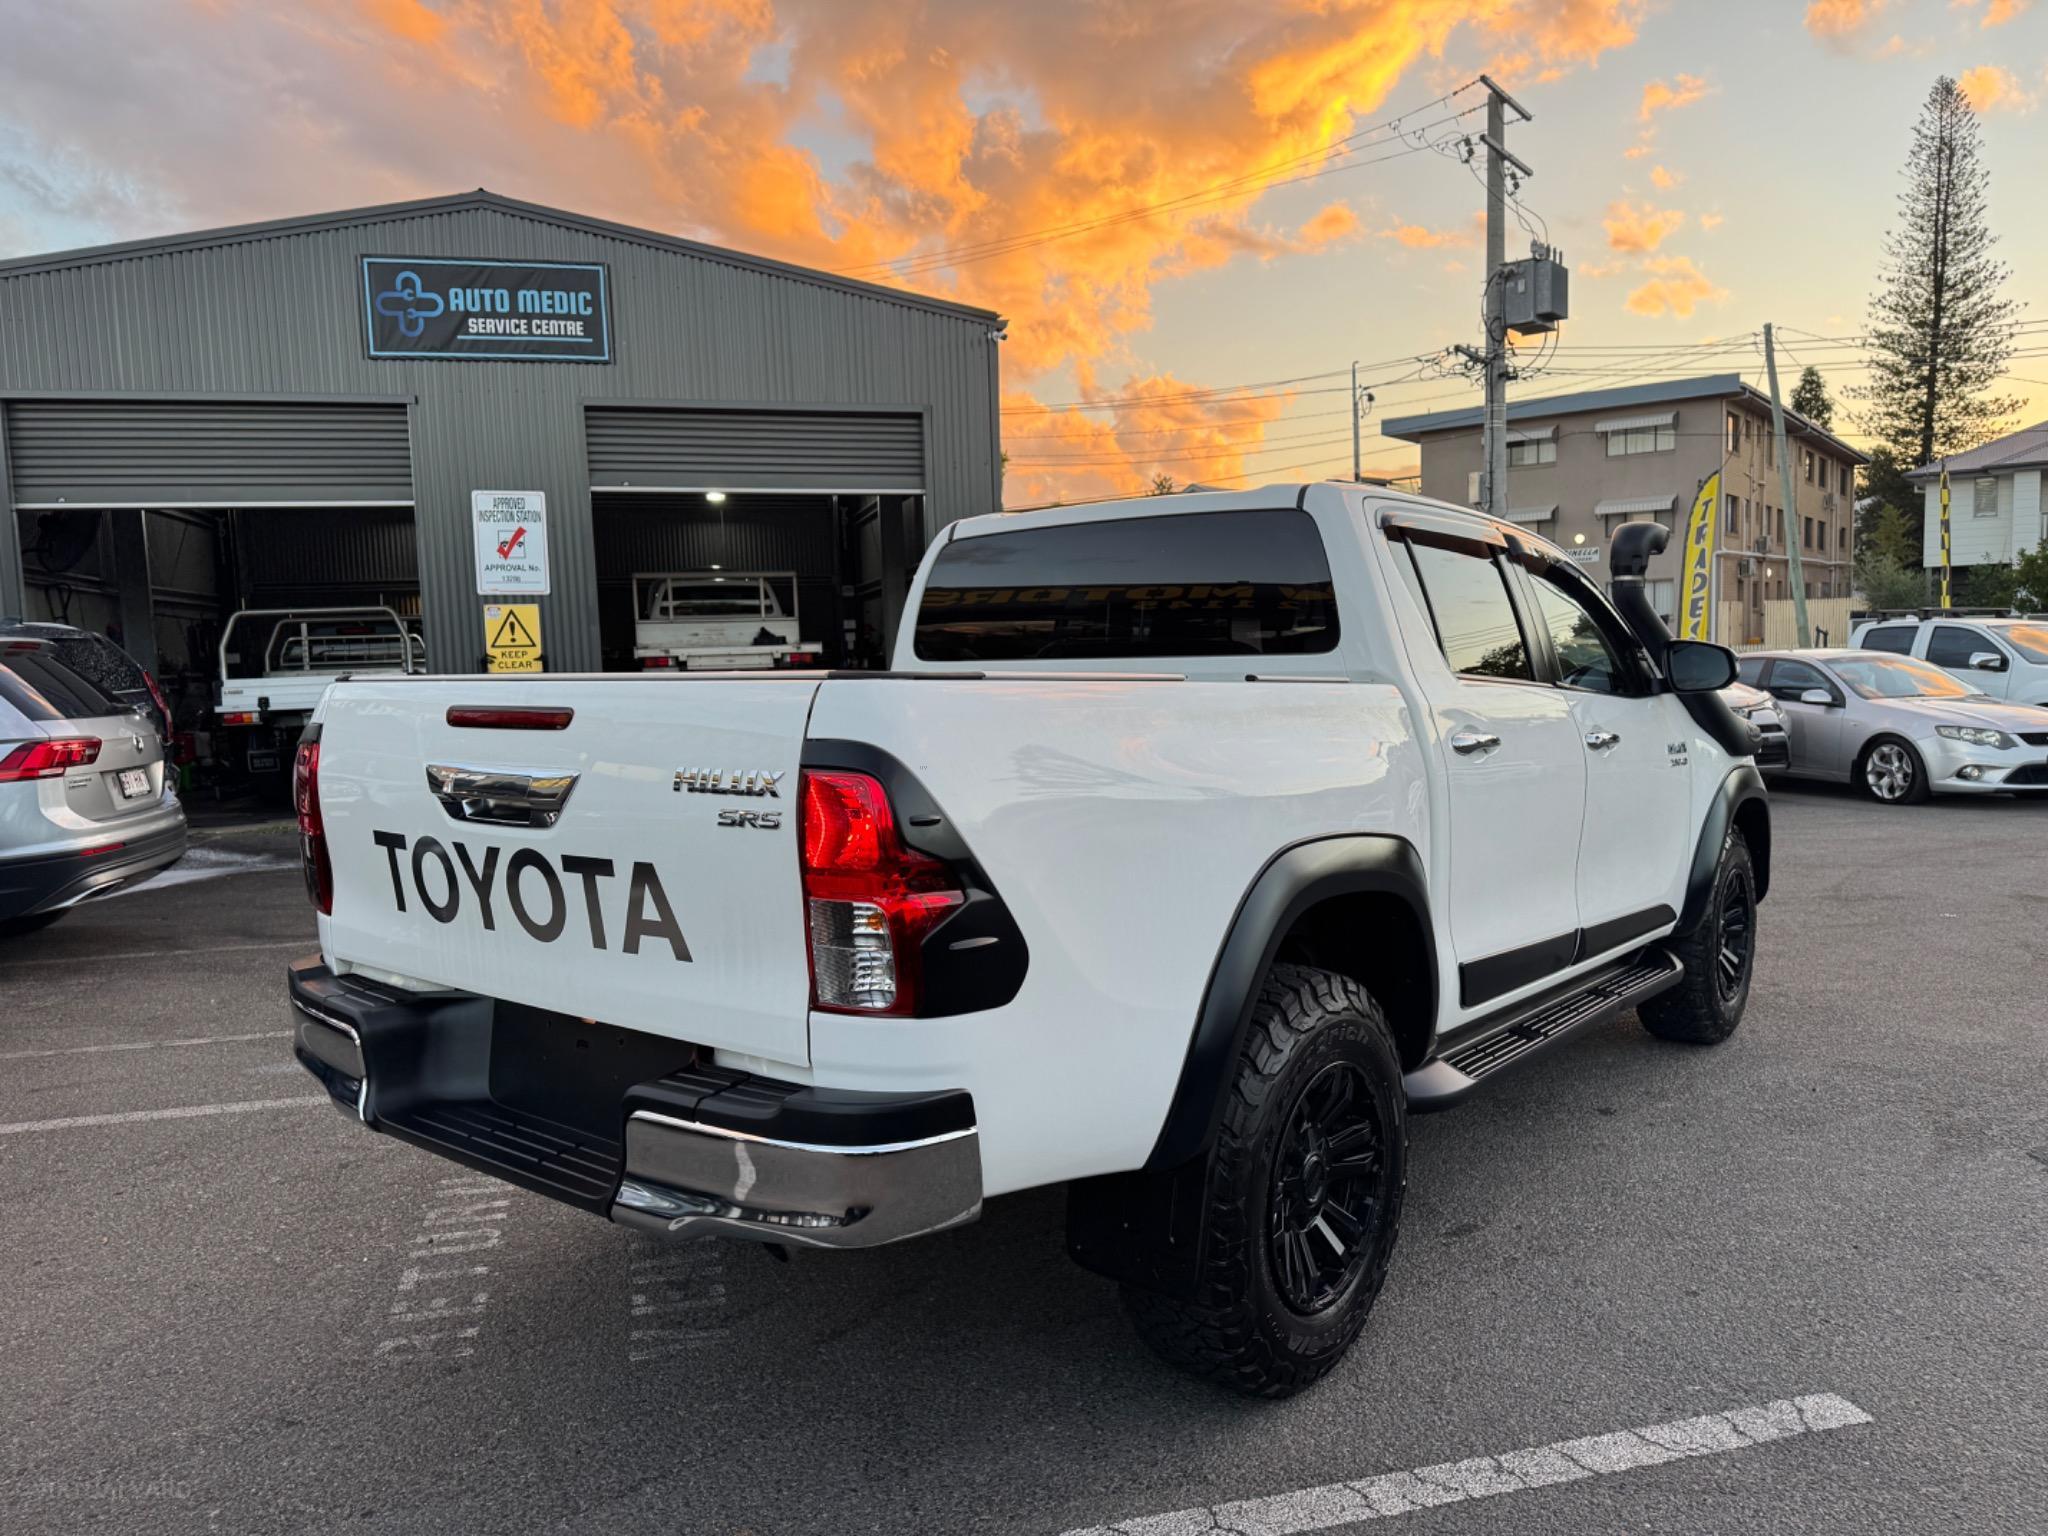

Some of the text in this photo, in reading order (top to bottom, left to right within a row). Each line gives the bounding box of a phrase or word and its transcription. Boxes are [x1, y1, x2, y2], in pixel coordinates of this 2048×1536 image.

[449, 288, 593, 315] AUTO MEDIC
[468, 318, 584, 336] SERVICE CENTRE
[493, 497, 526, 510] APPROVED
[479, 510, 542, 523] INSPECTION STATION
[484, 563, 527, 572] APPROVAL
[501, 651, 528, 659] KEEP
[498, 661, 532, 669] CLEAR
[673, 767, 785, 798] HILUX
[373, 829, 693, 963] TOYOTA
